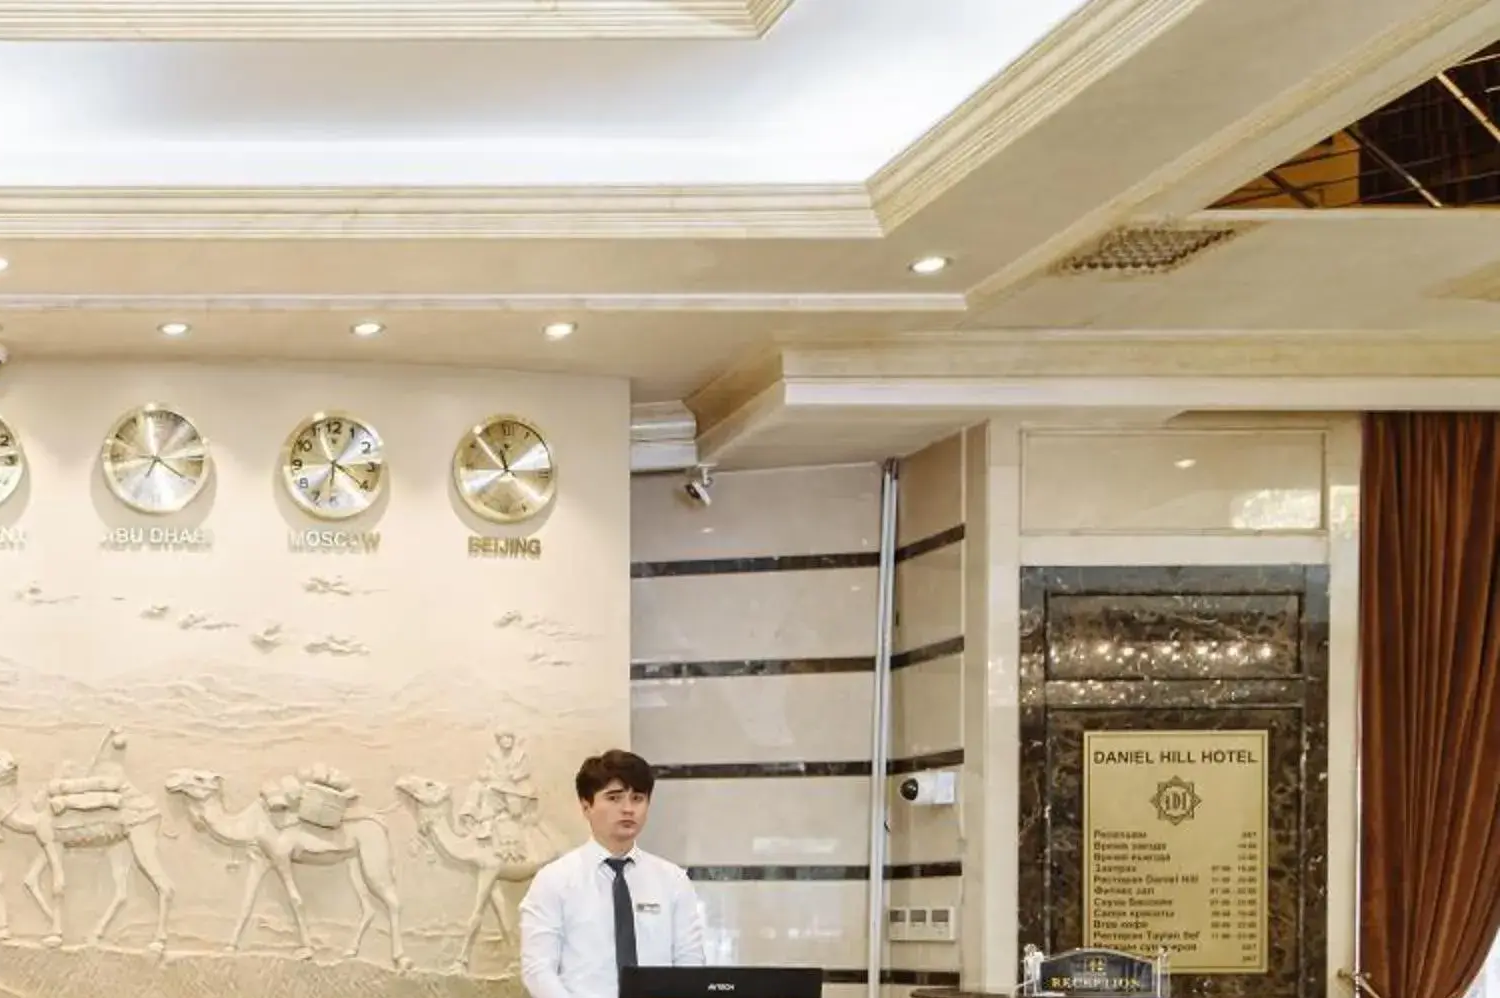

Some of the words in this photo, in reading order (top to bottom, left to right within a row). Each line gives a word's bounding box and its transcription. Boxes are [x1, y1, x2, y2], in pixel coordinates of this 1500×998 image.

[288, 530, 382, 552] MOSCOW
[468, 536, 542, 558] BEIJING
[1093, 750, 1155, 765] DANIEL
[1160, 750, 1197, 764] HILL
[1202, 750, 1259, 764] HOTEL
[1051, 976, 1142, 990] RECEPTION
